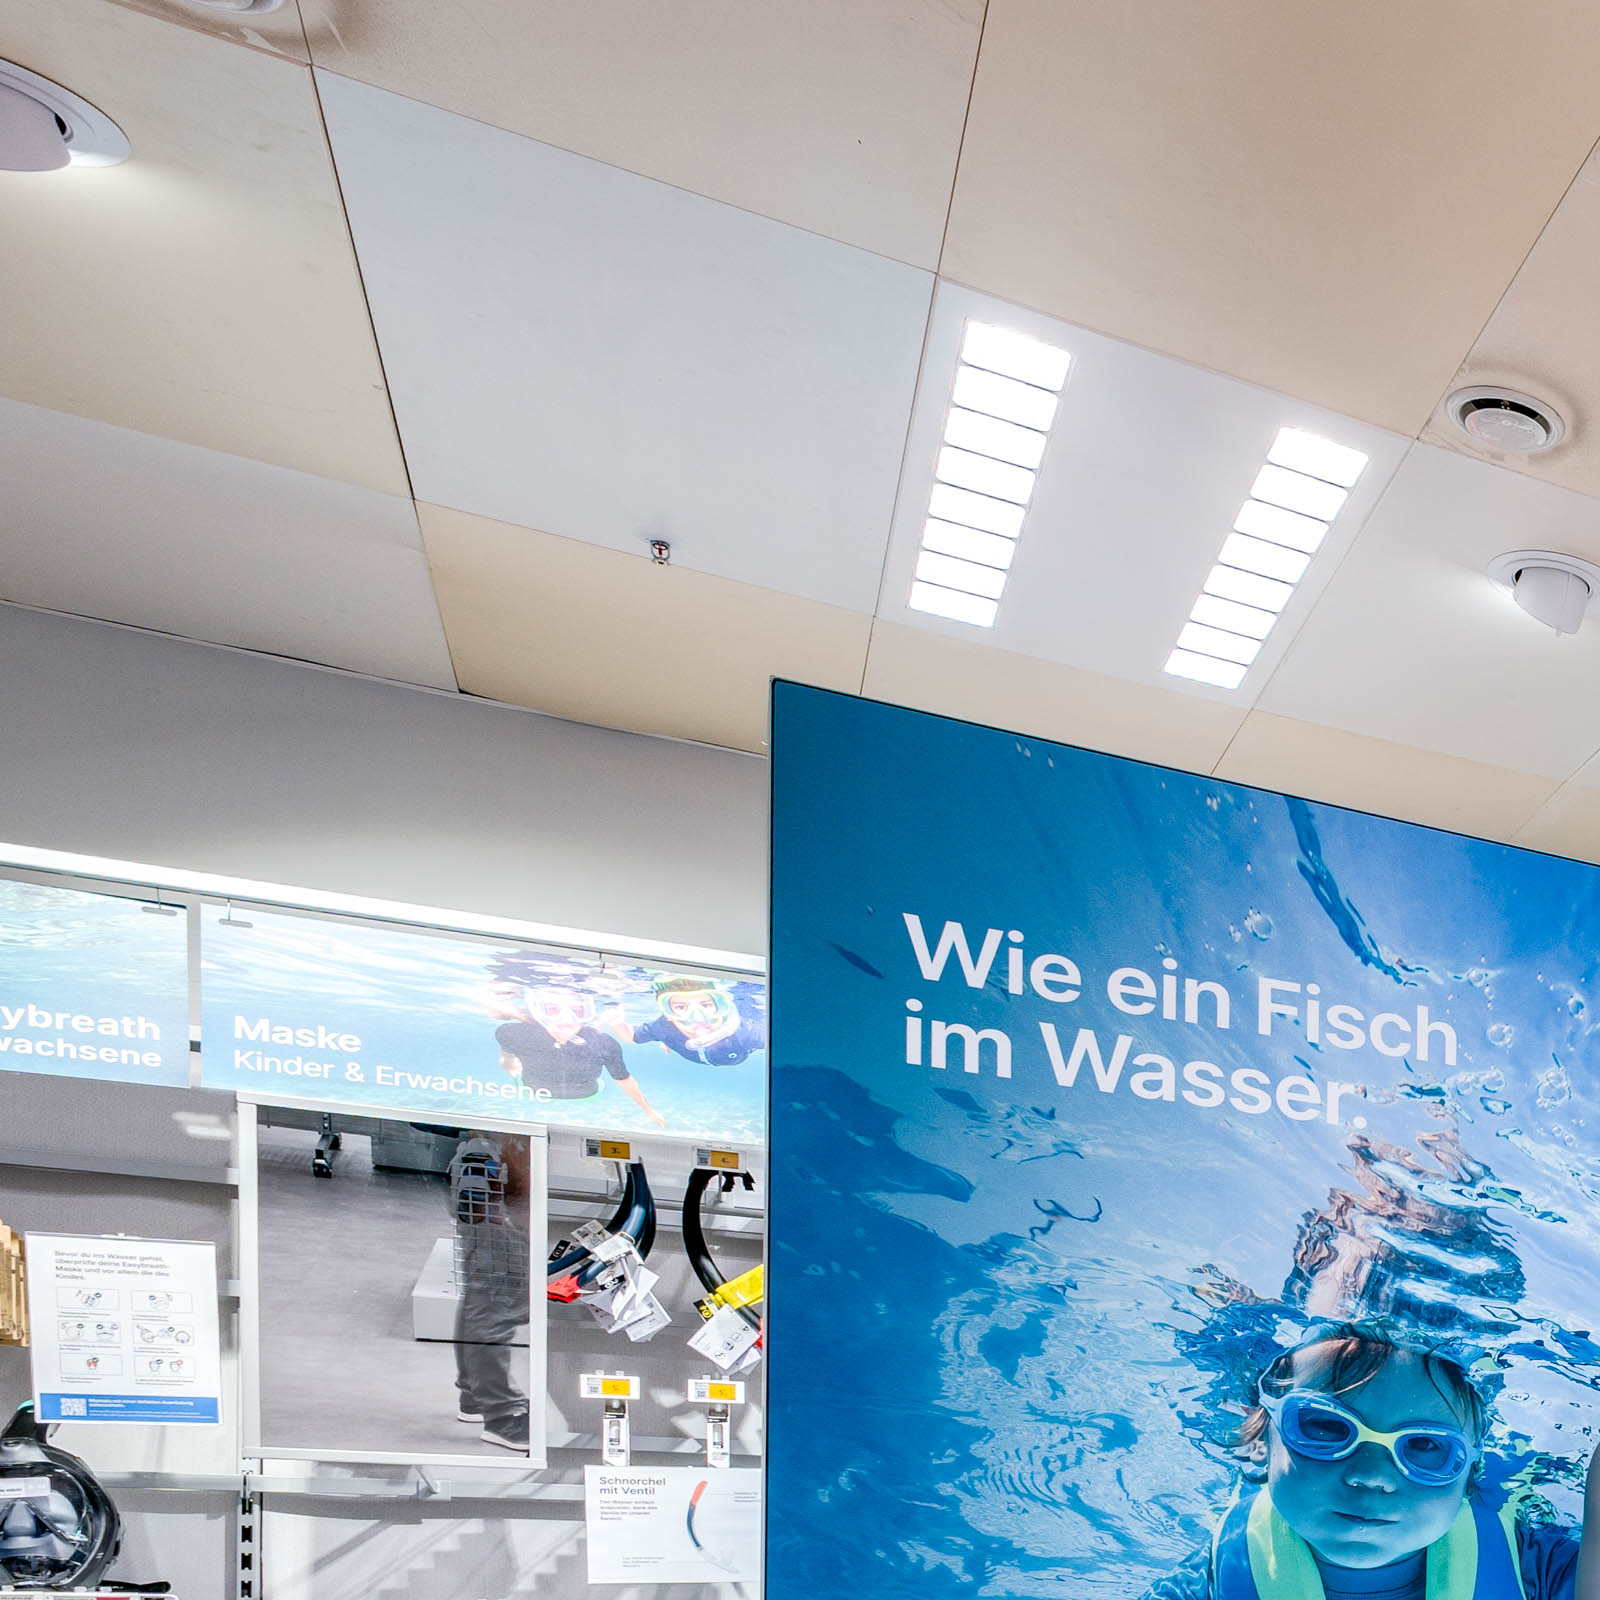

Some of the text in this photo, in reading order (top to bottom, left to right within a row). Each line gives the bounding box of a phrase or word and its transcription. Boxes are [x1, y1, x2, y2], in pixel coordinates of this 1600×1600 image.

[902, 912, 1458, 1067] Wie ein Fisch
[0, 1003, 161, 1041] ybreath
[234, 1015, 361, 1052] Maske
[234, 1049, 553, 1103] Kinder & Erwachsene
[905, 998, 1367, 1129] im Wasser.
[599, 1476, 667, 1487] Schnorchel
[599, 1486, 656, 1496] mit Ventil
